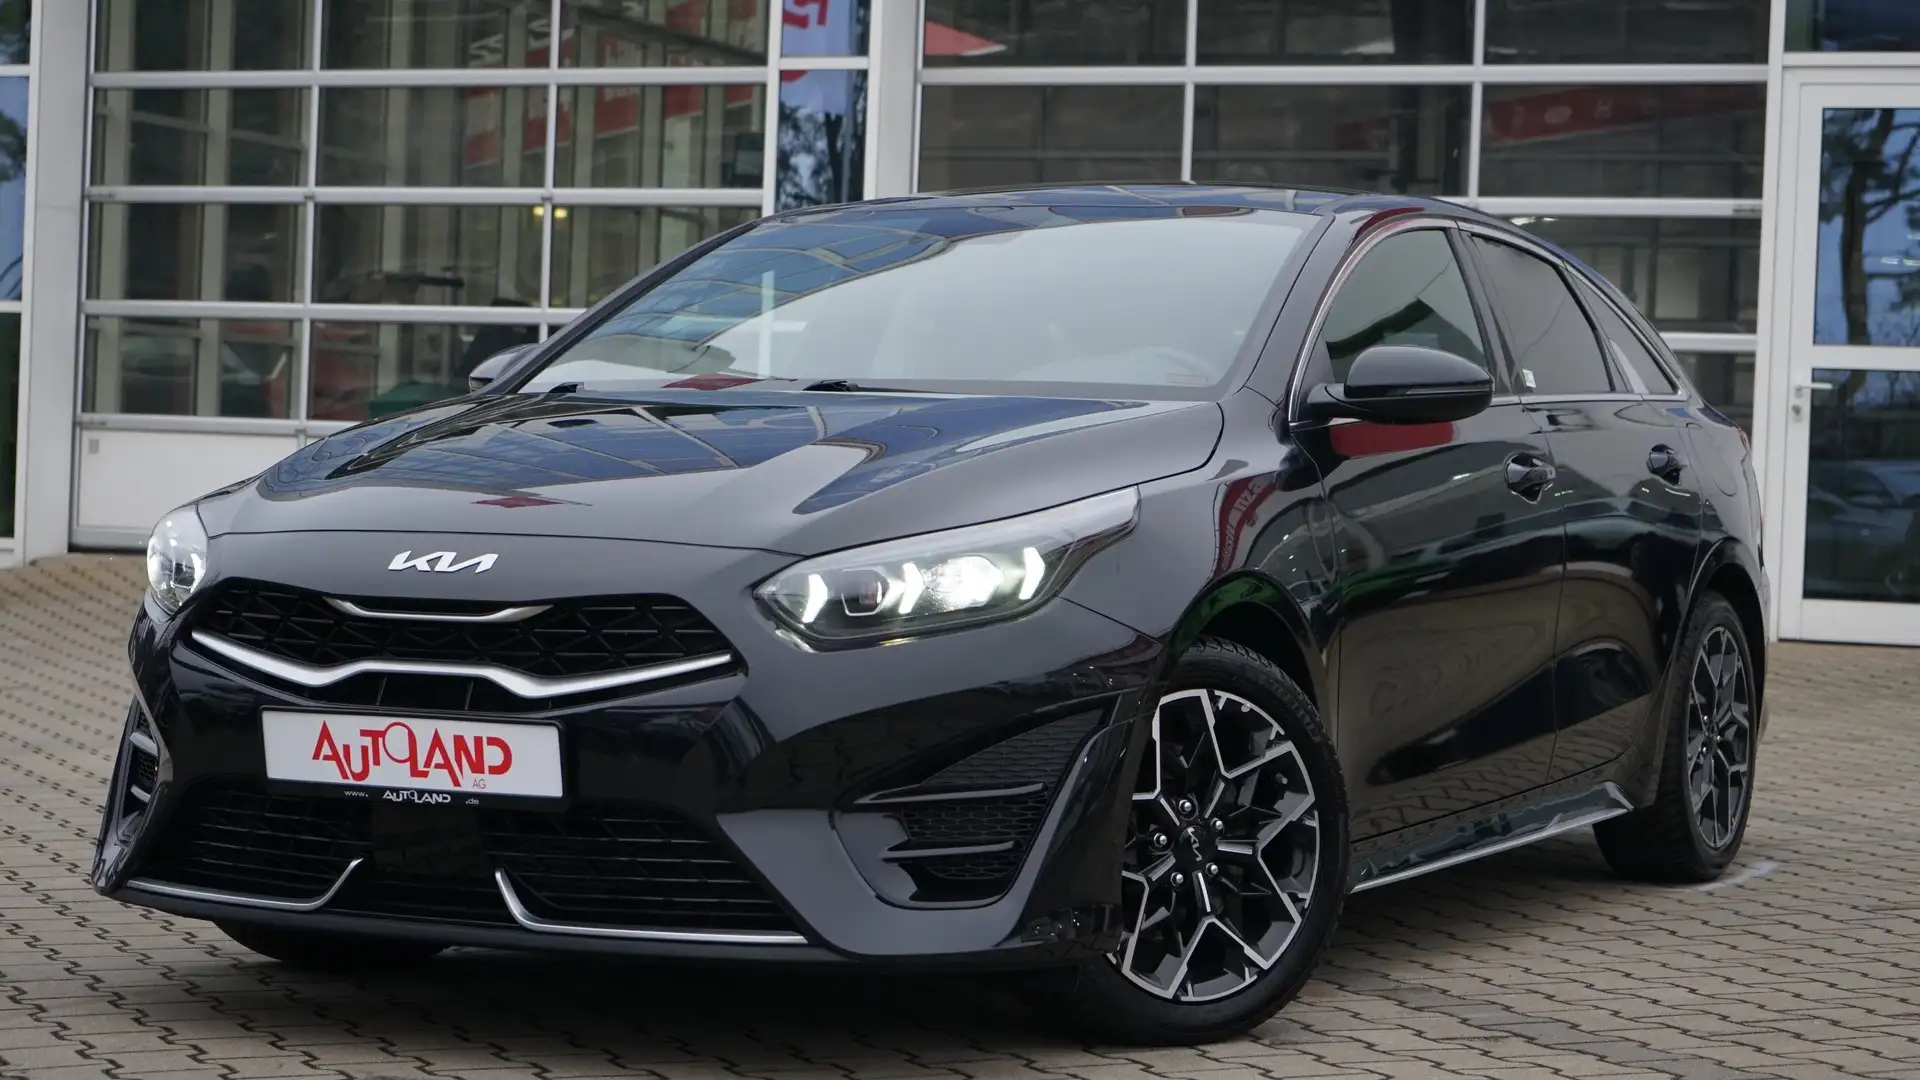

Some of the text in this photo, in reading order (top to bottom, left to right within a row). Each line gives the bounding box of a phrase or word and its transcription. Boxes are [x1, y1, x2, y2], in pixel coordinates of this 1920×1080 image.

[388, 550, 499, 574] KIA
[312, 720, 512, 787] AUTOLAND
[472, 778, 487, 789] AG
[383, 790, 451, 805] AUTOLAND
